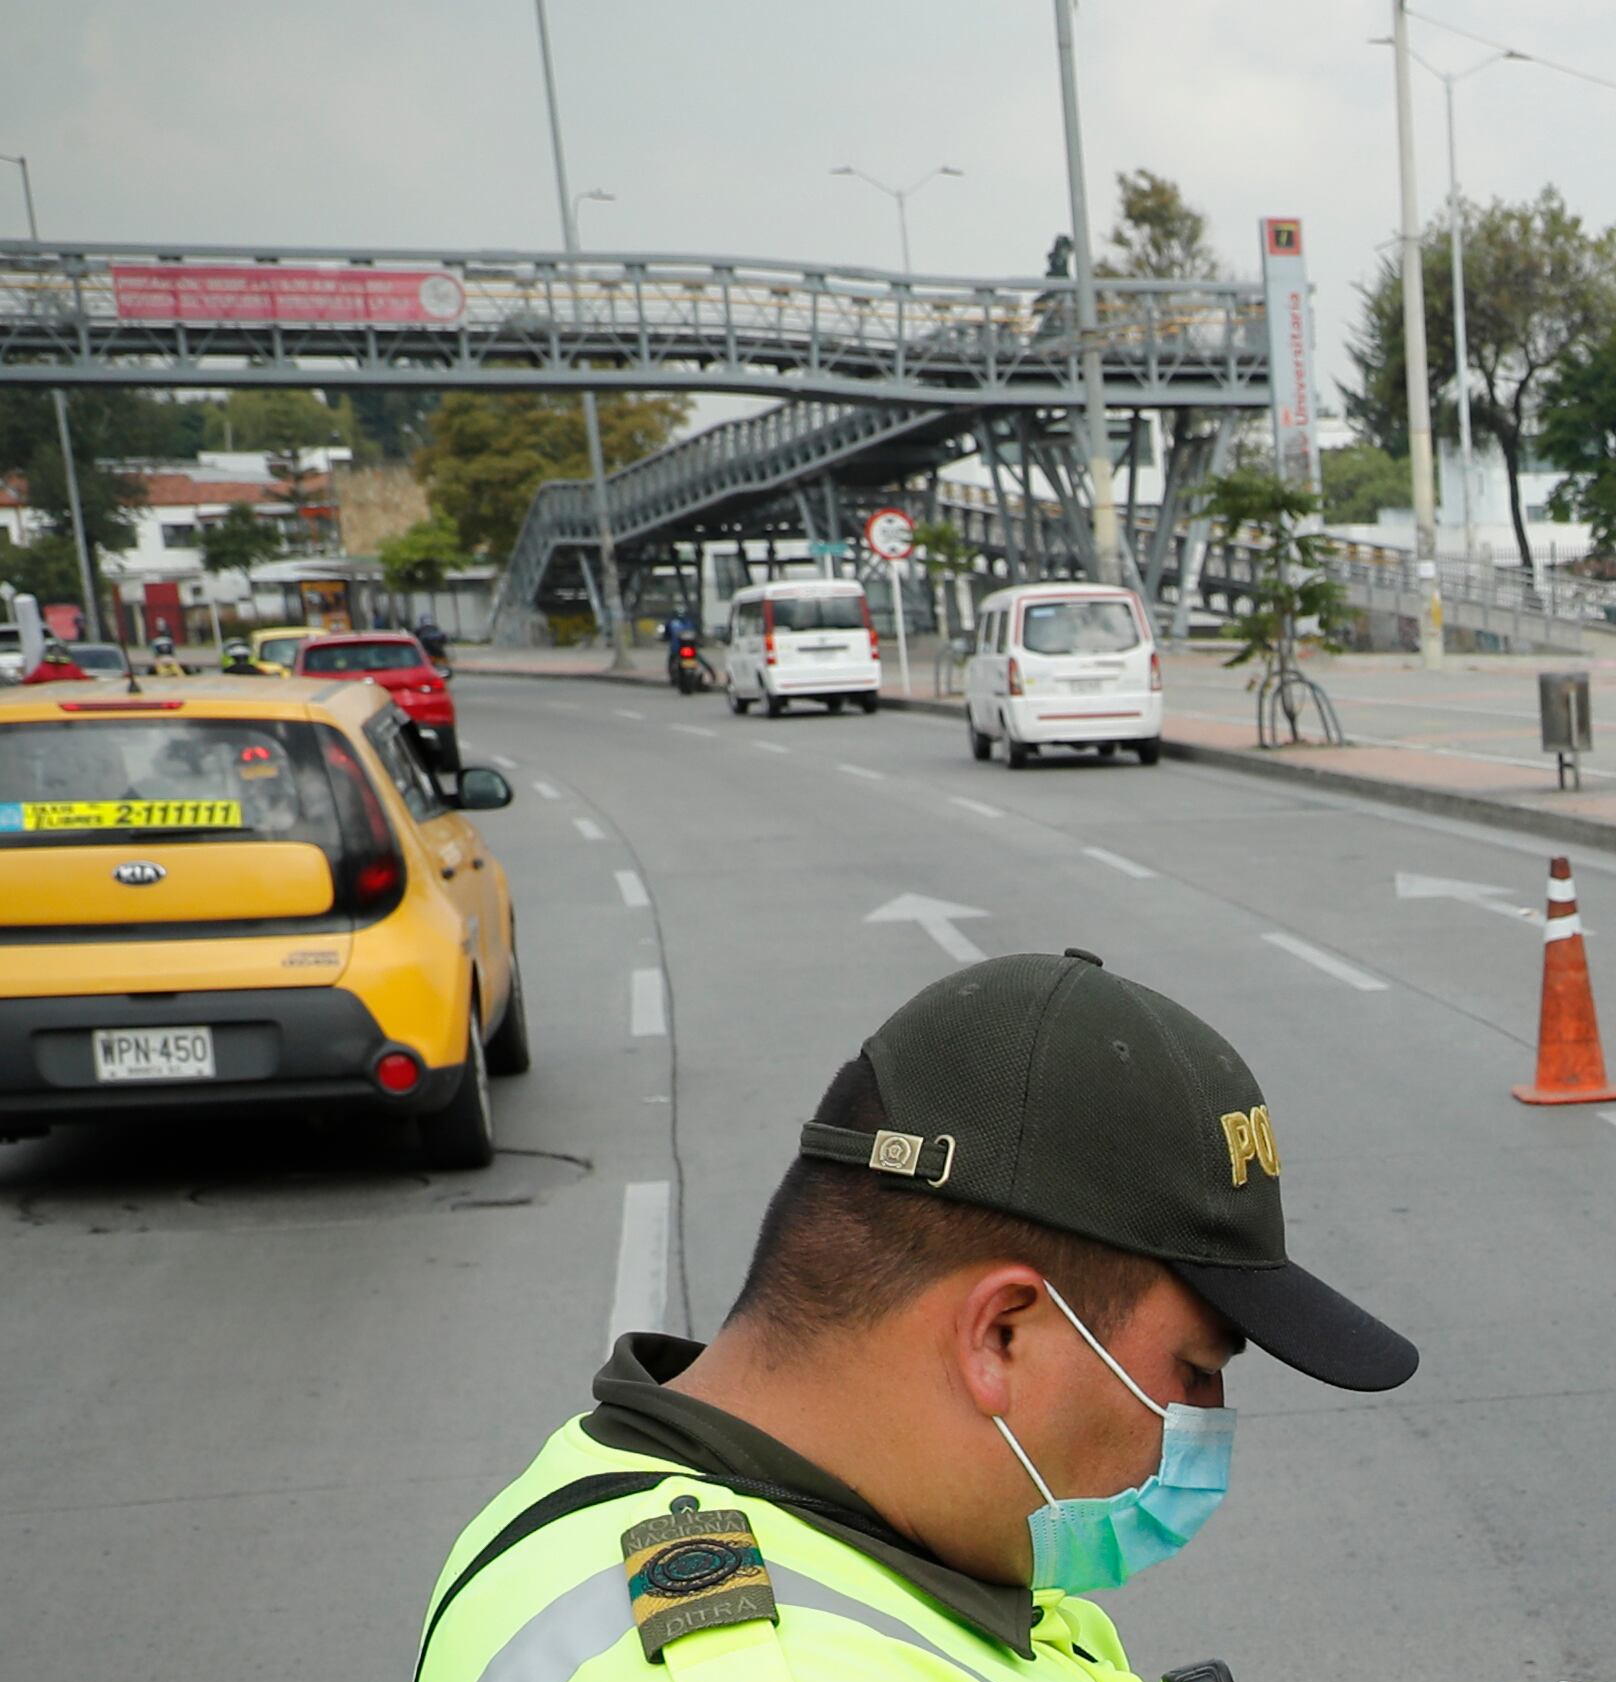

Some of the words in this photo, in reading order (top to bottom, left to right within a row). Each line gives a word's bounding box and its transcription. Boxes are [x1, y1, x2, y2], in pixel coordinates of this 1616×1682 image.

[1290, 290, 1309, 427] Universitaria
[116, 862, 163, 884] KIA
[1220, 1104, 1281, 1188] PO
[666, 1596, 757, 1636] DITRA
